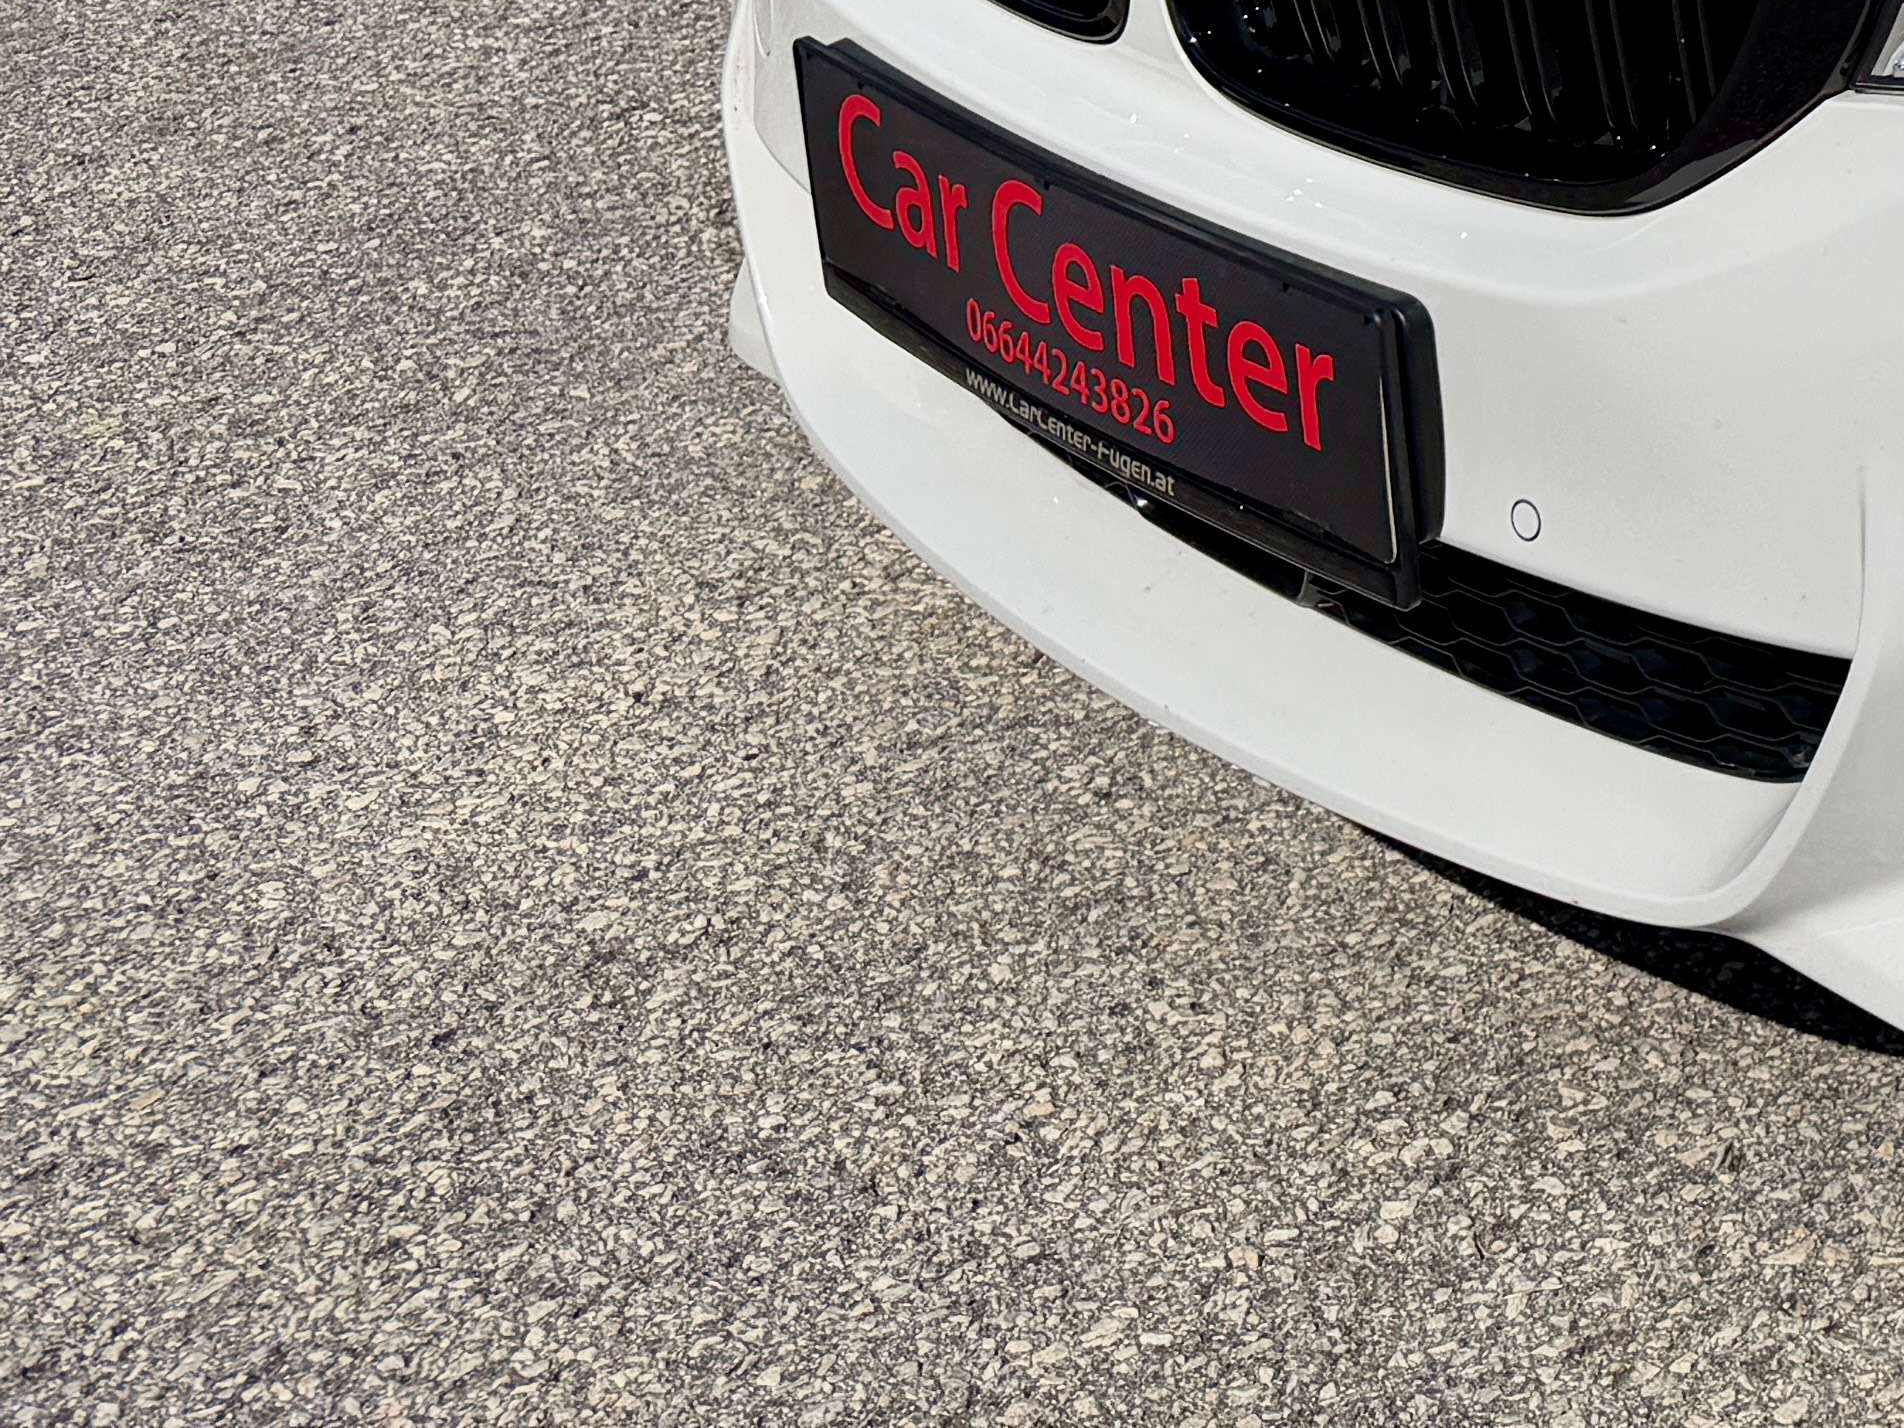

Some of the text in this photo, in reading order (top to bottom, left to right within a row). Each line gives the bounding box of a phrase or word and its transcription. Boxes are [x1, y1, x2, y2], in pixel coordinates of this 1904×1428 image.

[838, 94, 1334, 451] Car Center
[966, 298, 1176, 444] 06644243826
